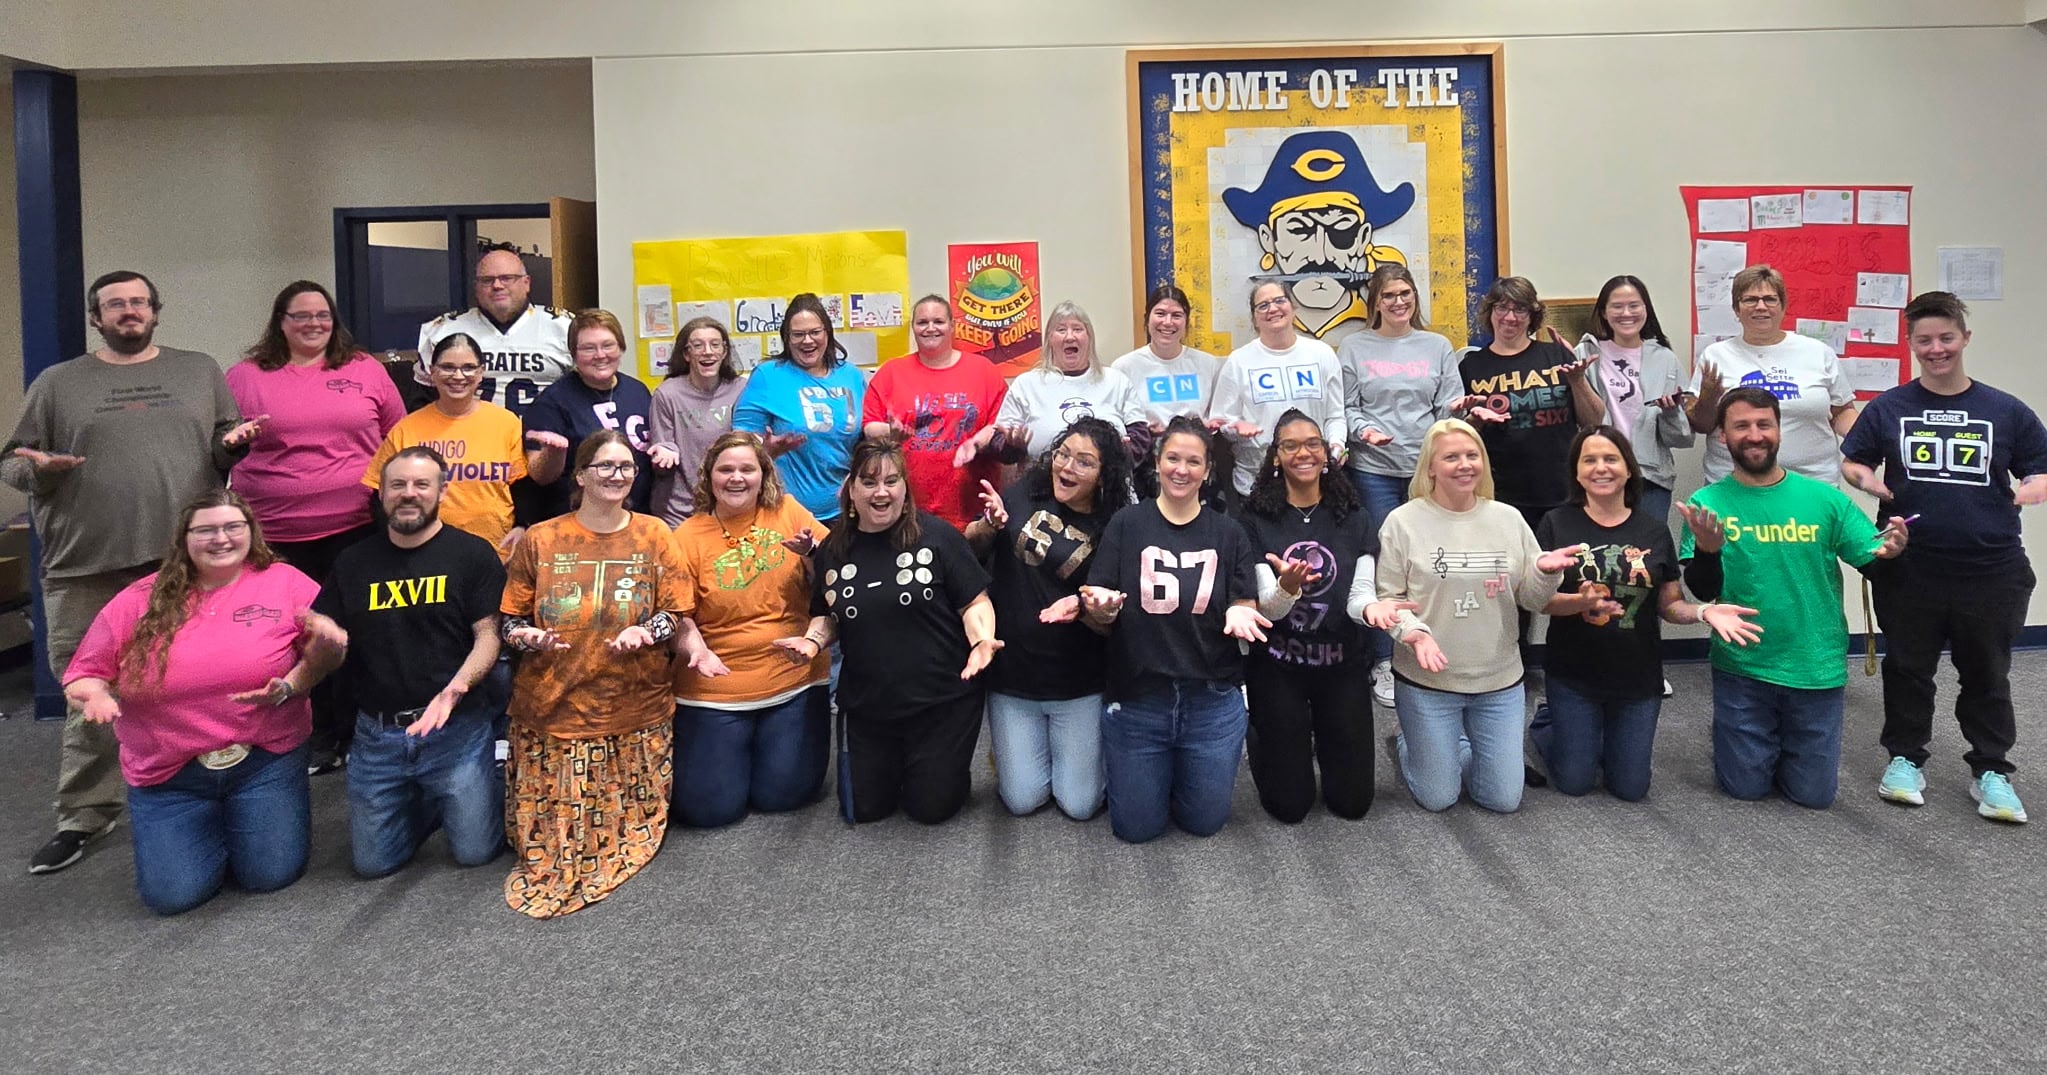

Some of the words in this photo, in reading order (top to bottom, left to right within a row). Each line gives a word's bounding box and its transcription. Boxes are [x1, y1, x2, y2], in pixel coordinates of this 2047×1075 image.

[1171, 71, 1288, 112] HOME
[1309, 69, 1357, 108] OF
[1378, 67, 1459, 107] THE
[1291, 149, 1346, 181] C
[962, 296, 987, 313] GET
[990, 292, 1031, 315] THERE
[955, 322, 994, 346] KEEP
[1000, 315, 1038, 346] GOING
[482, 352, 545, 372] RATES
[1770, 366, 1787, 375] Sei
[1153, 381, 1166, 394] C
[1180, 379, 1193, 392] N
[1258, 373, 1275, 389] C
[1296, 370, 1314, 387] N
[1471, 365, 1562, 394] WHAT
[1766, 373, 1795, 382] Sette
[799, 386, 855, 433] 67
[1486, 385, 1568, 413] OMES
[1929, 413, 1962, 423] SCORE
[1954, 431, 1983, 440] GUEST
[1916, 444, 1931, 462] 6
[1959, 447, 1976, 465] 7
[446, 461, 511, 482] VIOLET
[1726, 517, 1820, 542] 5-under
[1014, 510, 1093, 580] 67
[1140, 545, 1218, 615] 67
[368, 574, 448, 611] LXVII
[1289, 602, 1329, 632] 67
